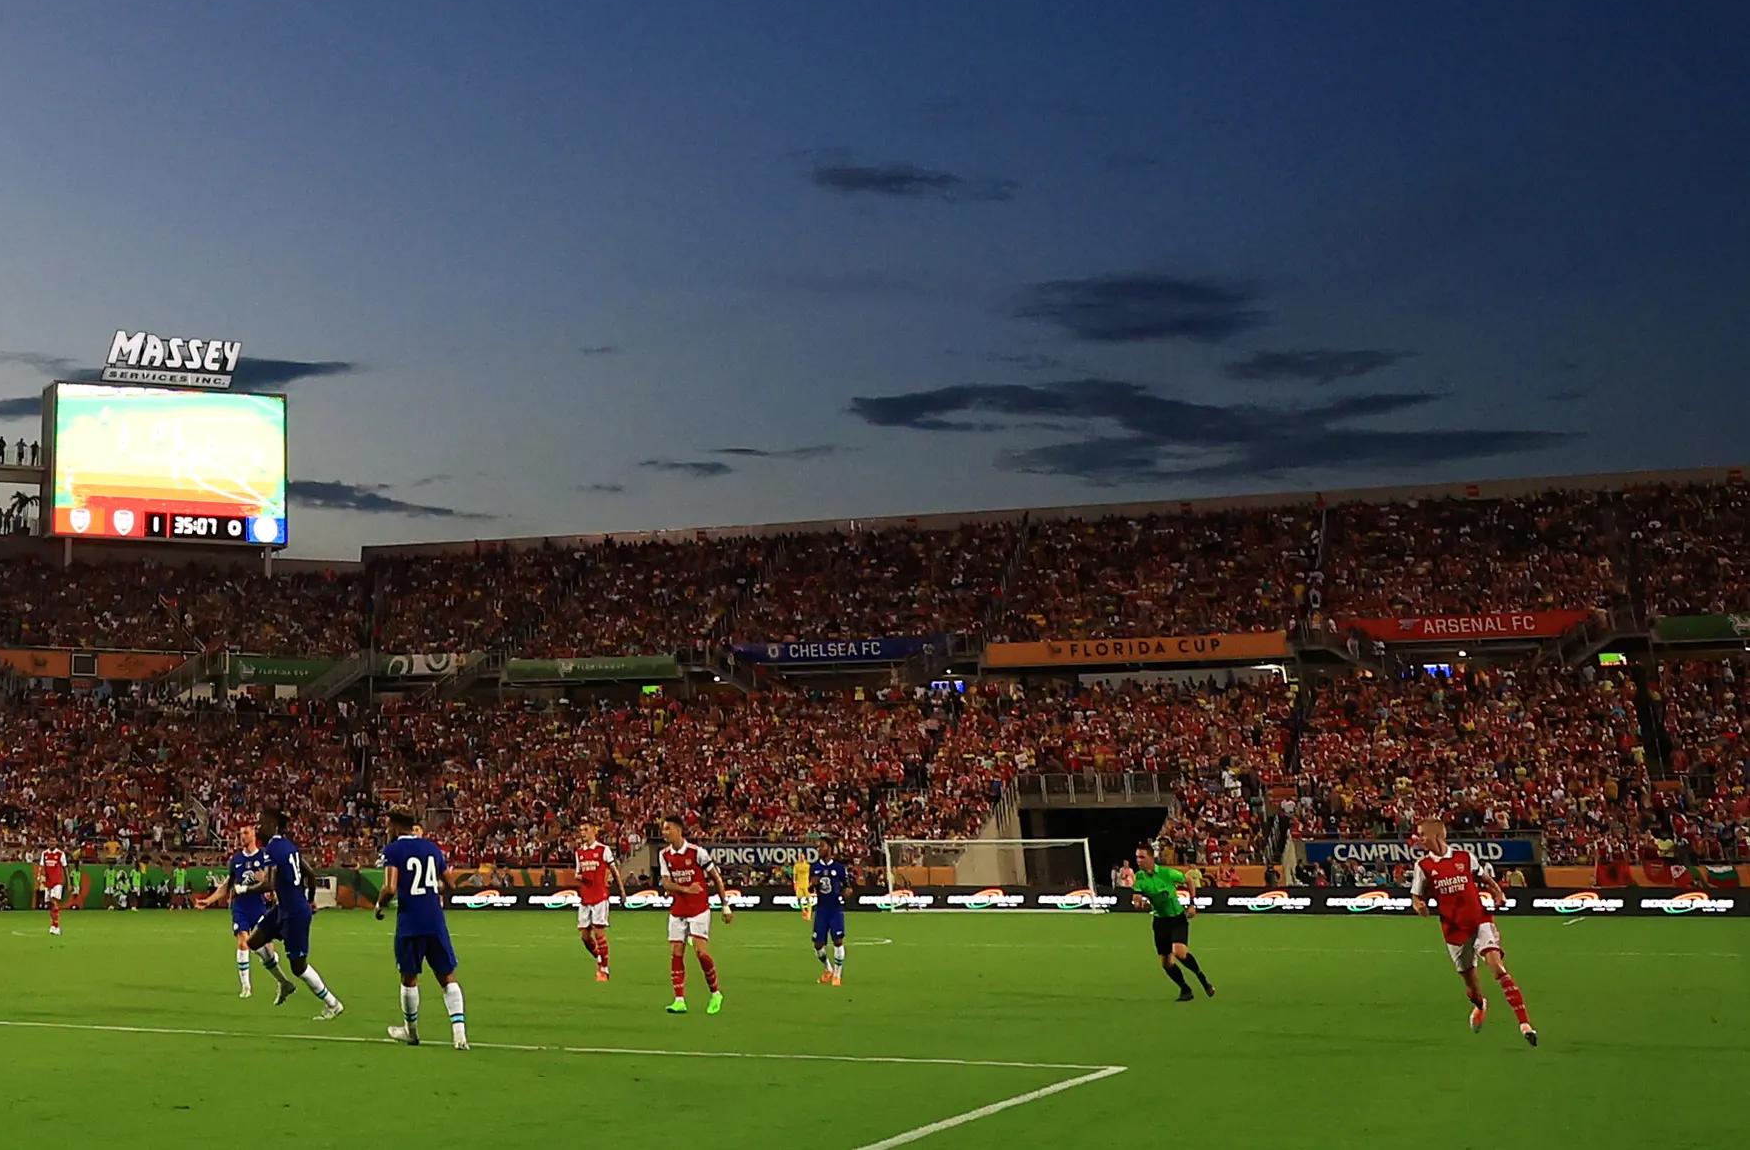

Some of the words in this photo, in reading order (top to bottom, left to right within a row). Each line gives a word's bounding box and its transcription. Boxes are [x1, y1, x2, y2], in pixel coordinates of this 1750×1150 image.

[107, 330, 242, 371] MASSEY
[108, 371, 188, 383] SERVICES
[195, 377, 226, 386] INC.
[174, 516, 217, 535] 35:07
[227, 519, 242, 536] 0
[1424, 616, 1506, 634] ARSENAL
[1512, 615, 1535, 630] FC
[789, 642, 857, 658] CHELSEA
[862, 641, 881, 656] FC
[1070, 641, 1166, 657] FLORIDA
[1178, 638, 1220, 653] CUP
[709, 847, 756, 864] MPING
[1334, 844, 1425, 861] CAMPING
[406, 855, 439, 895] 24
